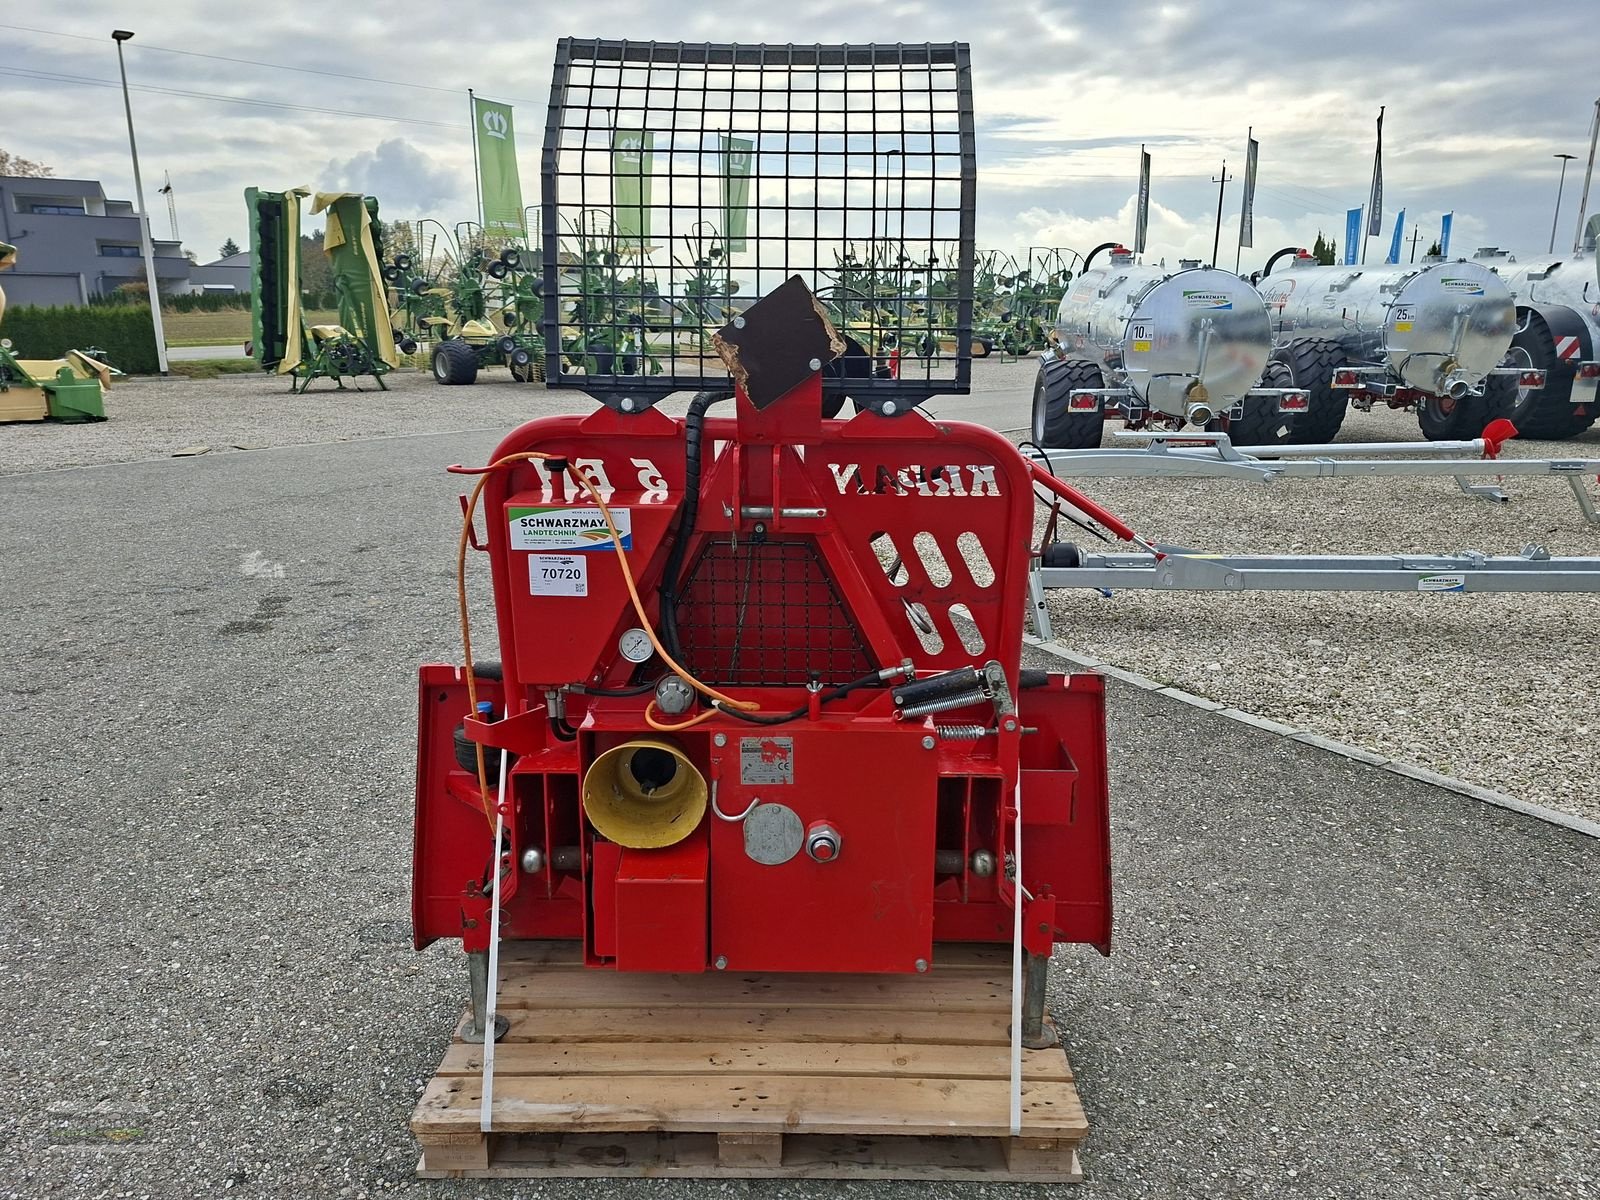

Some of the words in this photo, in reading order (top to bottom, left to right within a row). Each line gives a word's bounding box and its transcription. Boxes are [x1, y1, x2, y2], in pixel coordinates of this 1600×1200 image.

[1396, 308, 1408, 320] 25
[1134, 325, 1145, 339] 10
[541, 568, 581, 580] 70720
[777, 762, 790, 771] CE
